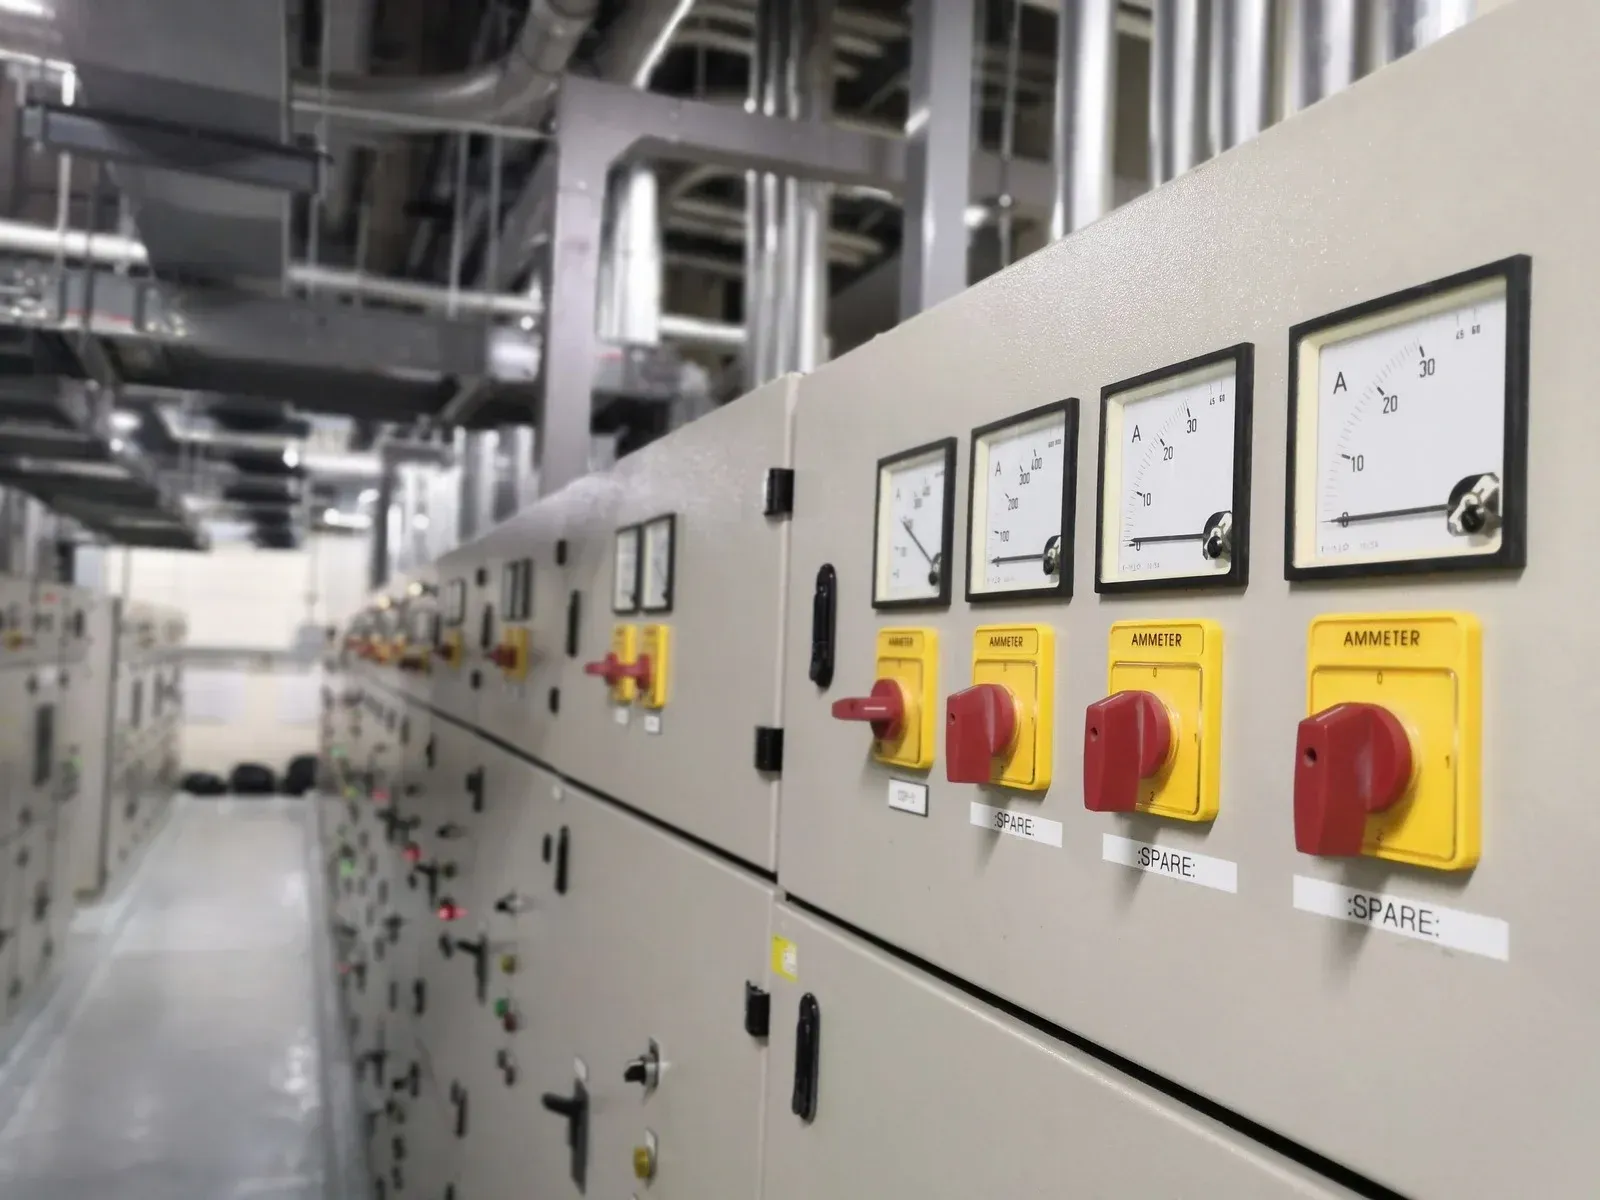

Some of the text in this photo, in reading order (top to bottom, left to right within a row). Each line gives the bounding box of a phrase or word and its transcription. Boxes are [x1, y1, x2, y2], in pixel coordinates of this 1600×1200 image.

[1455, 328, 1465, 340] 45
[1418, 358, 1436, 379] 30
[1332, 371, 1348, 394] A
[1382, 394, 1399, 414] 20
[1131, 424, 1142, 443] A
[1186, 418, 1198, 434] 30
[1163, 445, 1174, 461] 20
[995, 460, 1002, 477] A
[1031, 457, 1043, 471] 400
[1351, 454, 1365, 473] 10
[1019, 472, 1031, 486] 300
[1008, 497, 1019, 511] 200
[1142, 492, 1152, 507] 10
[999, 530, 1010, 542] 100
[988, 635, 1024, 648] AMMETER
[1131, 632, 1183, 647] AMMETER
[1343, 629, 1422, 647] AMMETER
[1152, 666, 1158, 678] 0
[1376, 671, 1384, 685] 0
[1445, 754, 1451, 769] 1
[994, 811, 1035, 837] :SPARE:
[1136, 845, 1197, 878] :SPARE:
[1347, 893, 1440, 938] :SPARE:
